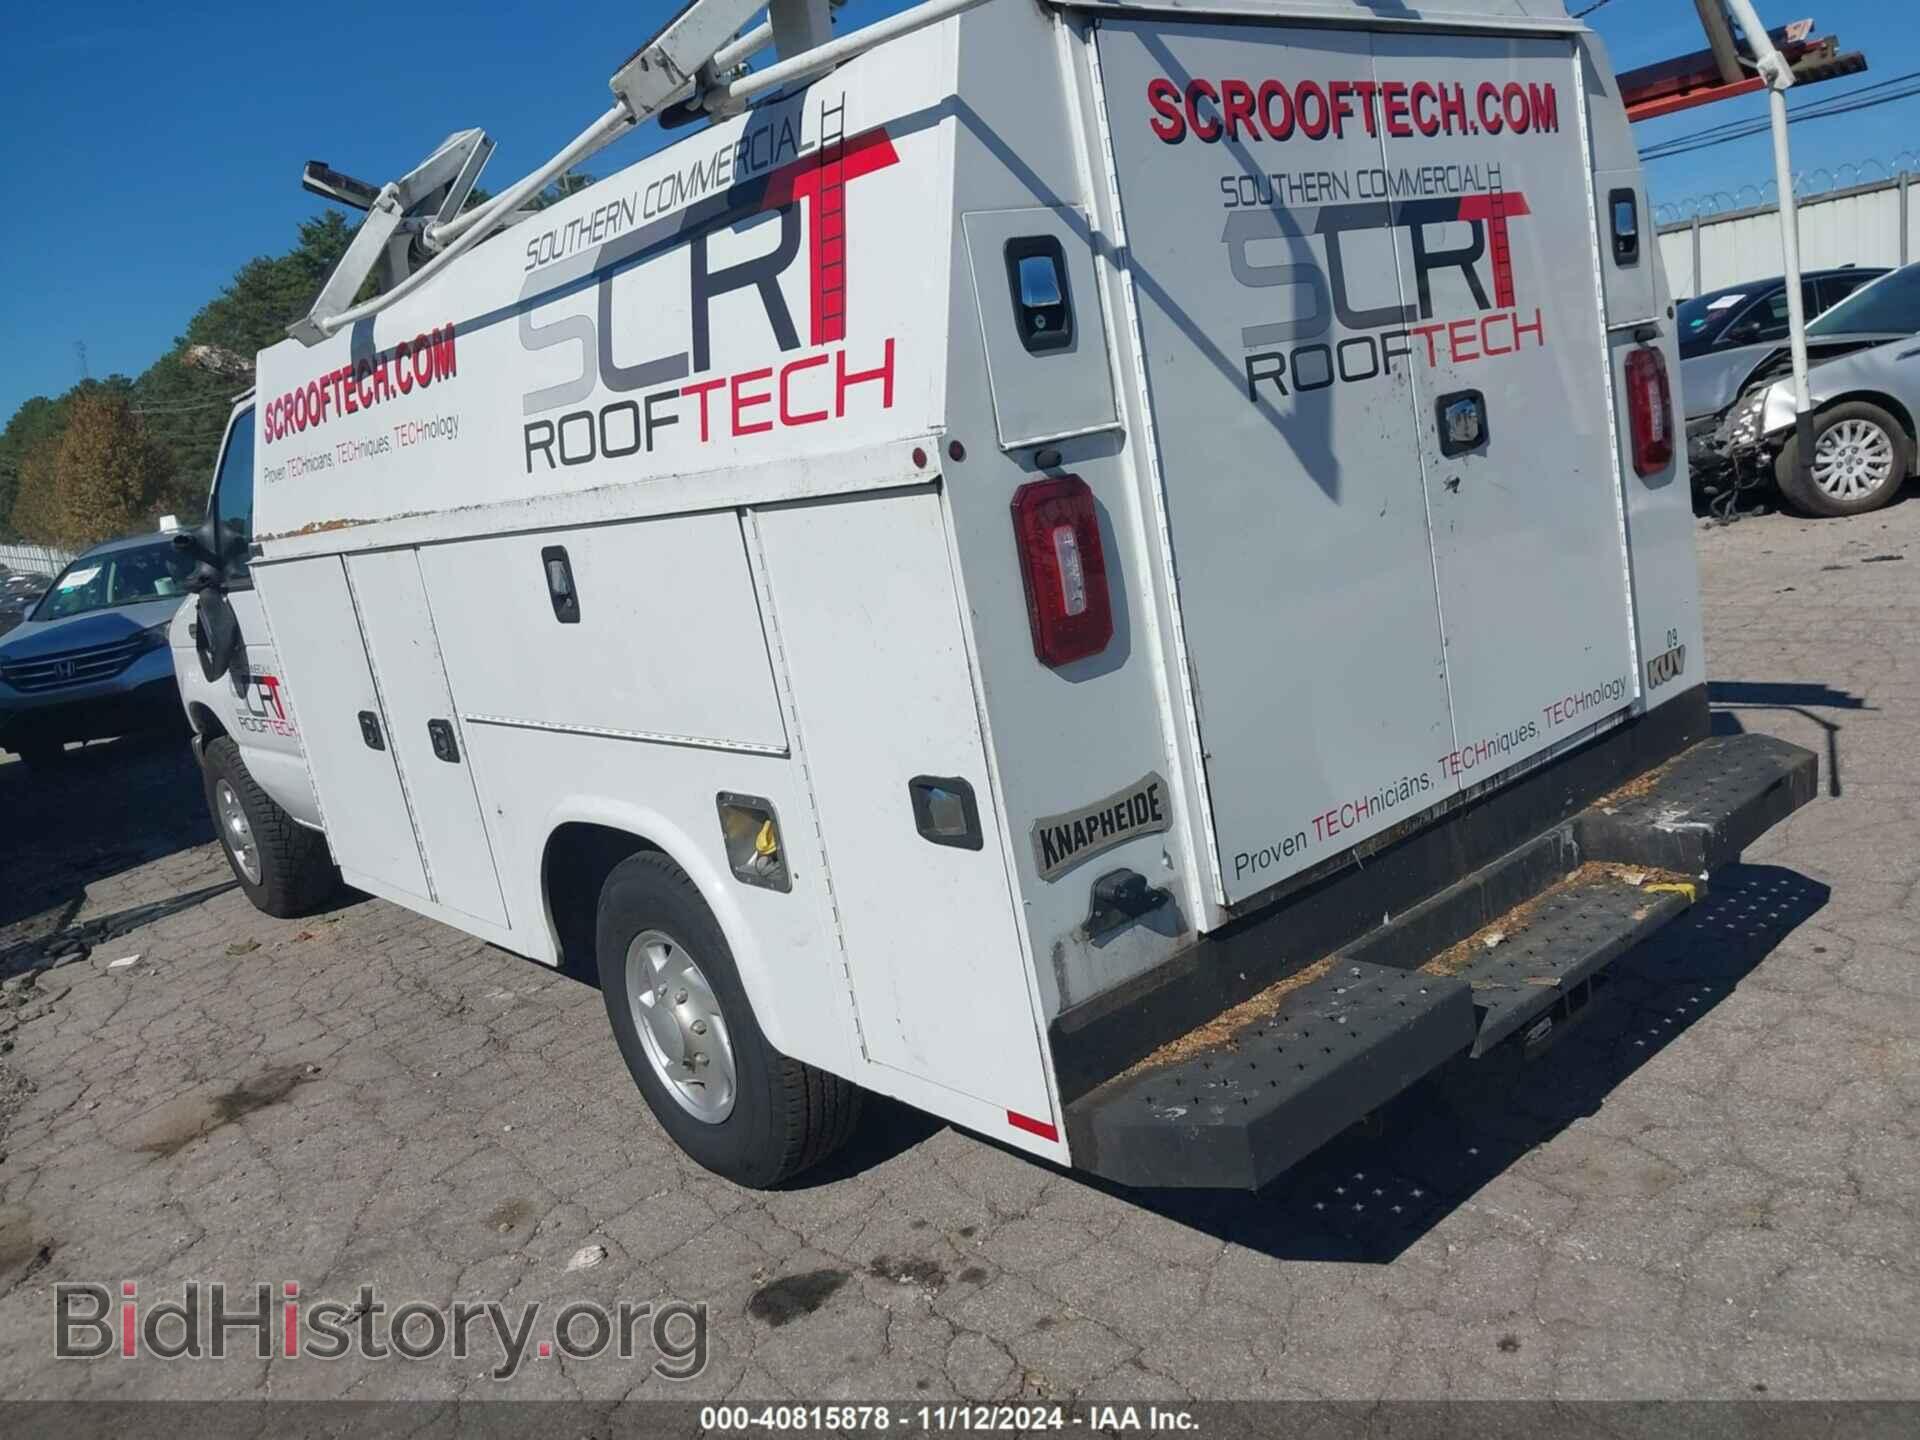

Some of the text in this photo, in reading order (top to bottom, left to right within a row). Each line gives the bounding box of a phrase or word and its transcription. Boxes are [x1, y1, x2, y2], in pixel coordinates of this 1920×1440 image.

[1147, 78, 1559, 145] SCROOFTECH.COM
[525, 114, 815, 271] SOUTHERN COMMERCIAL
[1220, 163, 1486, 208] SOUTHERN COMMERCIAL
[519, 127, 900, 416] SCRT
[1221, 191, 1531, 348] SCRT
[264, 322, 457, 444] SCROOFTECH.COM
[525, 338, 895, 473] ROOFTECH
[1245, 308, 1543, 402] ROOFTECH
[264, 466, 286, 483] Proven
[394, 414, 459, 449] TECHnology
[1647, 644, 1686, 690] KUV
[1039, 783, 1162, 870] KNAPHEIDE
[1234, 831, 1307, 880] Proven
[1438, 720, 1541, 779] TECHniques,
[1543, 675, 1626, 729] TECHnology
